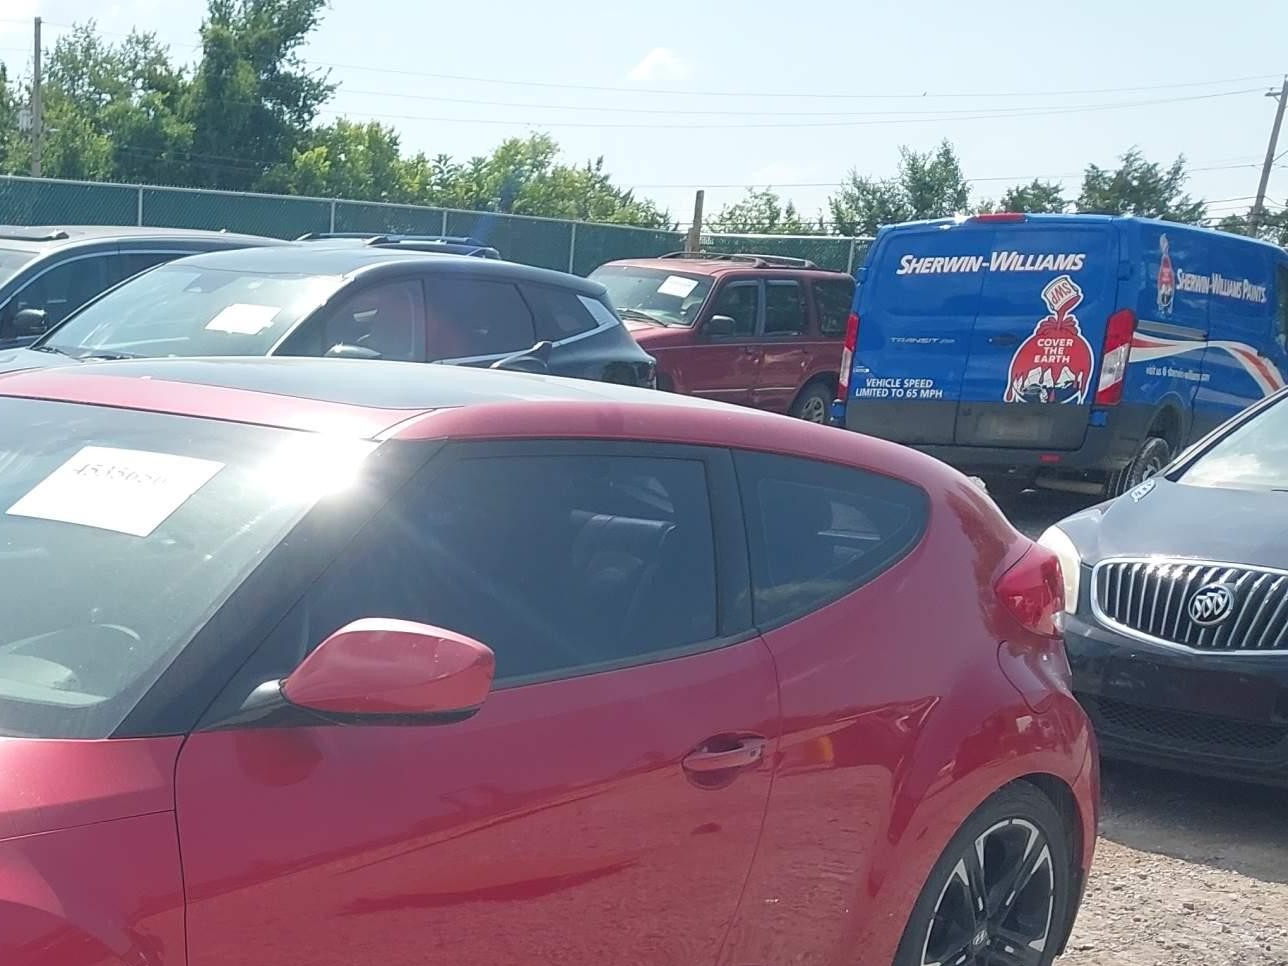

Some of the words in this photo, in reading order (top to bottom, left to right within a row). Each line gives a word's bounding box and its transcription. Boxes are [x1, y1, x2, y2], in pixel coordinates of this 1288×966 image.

[896, 251, 1086, 275] SHERWIN-WILLIAMS
[1176, 268, 1242, 299] SHERWIN-WILLIAMS
[1242, 279, 1267, 303] PAINTS
[1051, 282, 1072, 304] SWP
[1037, 338, 1074, 347] COVER
[1044, 347, 1064, 355] THE
[1034, 355, 1070, 363] EARTH
[866, 378, 902, 388] VEHICLE
[903, 379, 933, 388] SPEED
[855, 388, 889, 397] LIMITED
[891, 388, 904, 398] TO
[906, 389, 917, 398] 65
[919, 389, 943, 398] MPH
